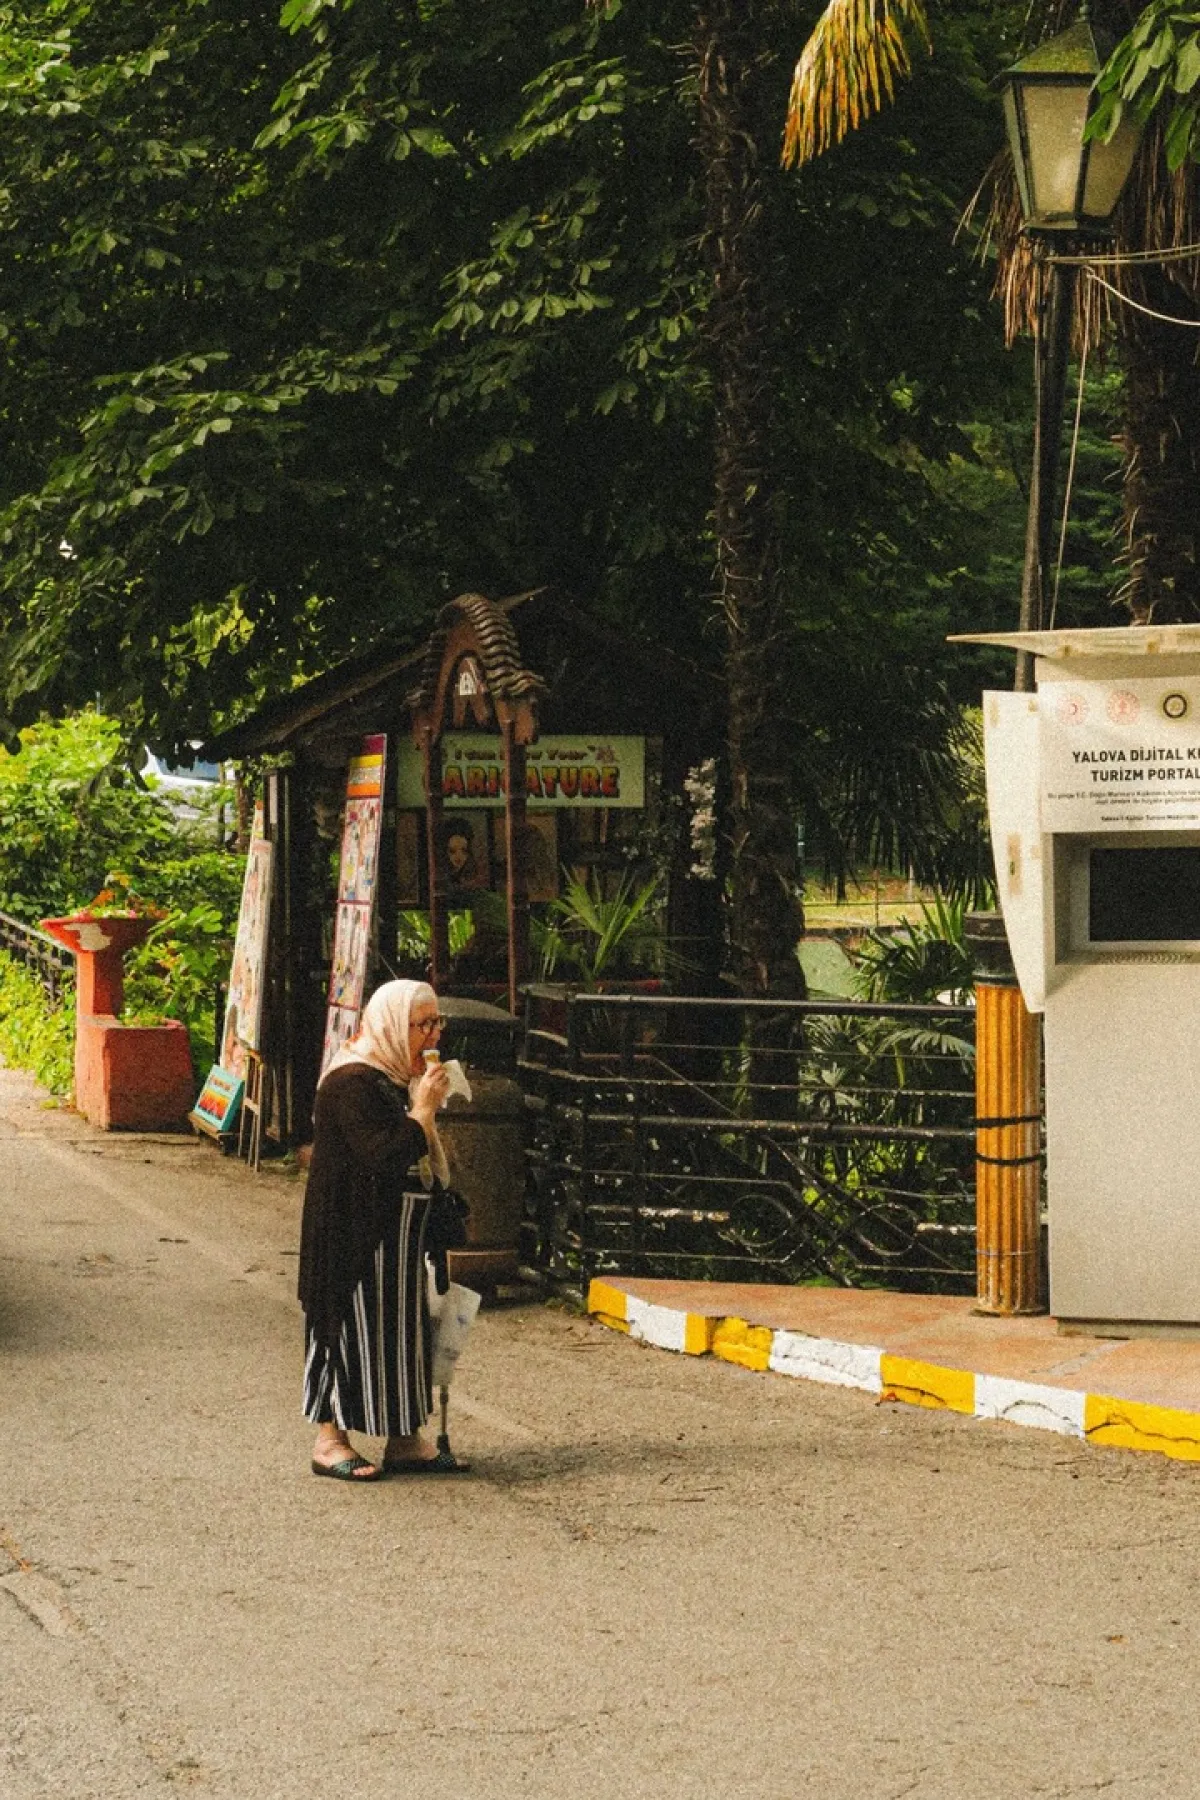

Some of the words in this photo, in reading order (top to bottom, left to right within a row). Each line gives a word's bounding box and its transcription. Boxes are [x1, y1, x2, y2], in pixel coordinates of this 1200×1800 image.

[1072, 750, 1126, 763] YALOVA
[1130, 747, 1183, 761] DİJİTAL
[1187, 747, 1200, 761] K
[423, 766, 619, 799] ARIATURE
[1090, 767, 1144, 782] TURİZM
[1147, 767, 1200, 781] PORTAL
